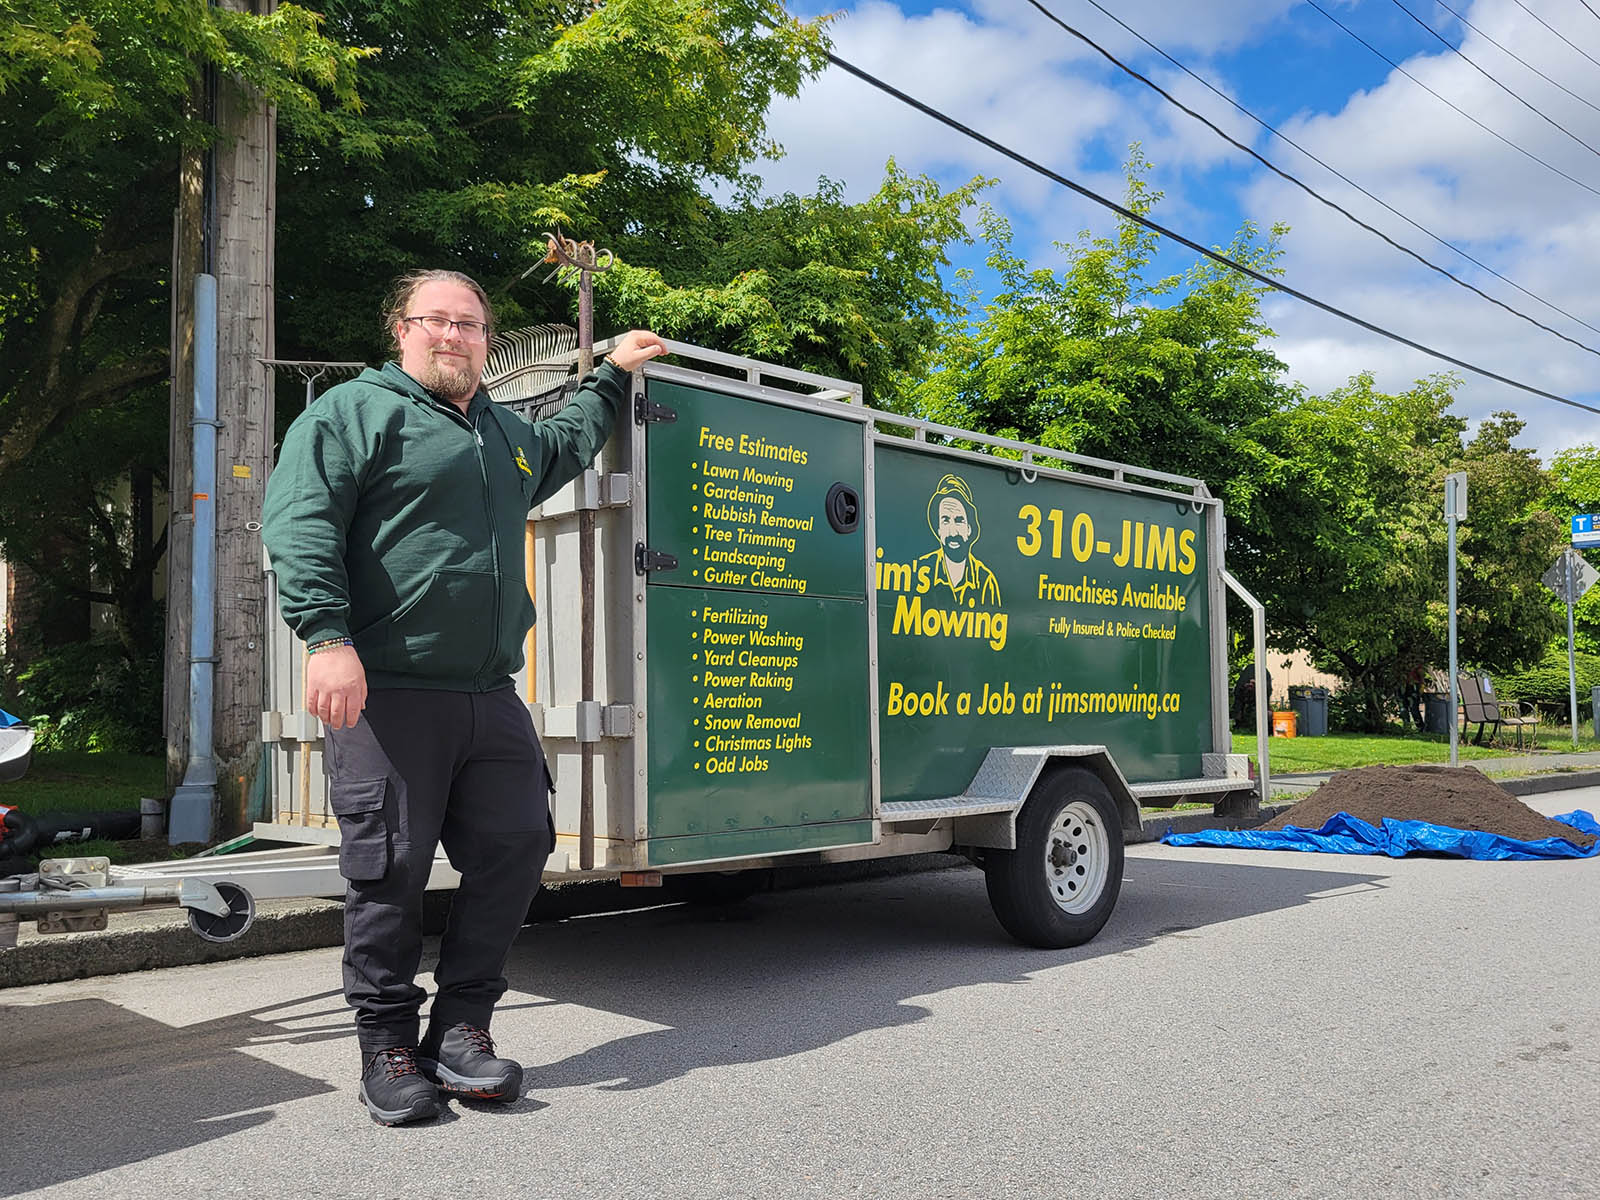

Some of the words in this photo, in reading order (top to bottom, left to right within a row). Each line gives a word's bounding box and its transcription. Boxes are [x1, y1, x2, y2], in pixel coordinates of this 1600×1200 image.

[698, 426, 735, 453] Free
[738, 433, 809, 465] Estimates
[703, 459, 740, 481] Lawn
[742, 466, 795, 493] Mowing
[703, 481, 775, 510] Gardening
[703, 502, 757, 524] Rubbish
[760, 509, 814, 532] Removal
[704, 523, 733, 543] Tree
[736, 527, 797, 553] Trimming
[1016, 503, 1197, 576] 310-JIMS
[703, 544, 786, 573] Landscaping
[875, 546, 931, 594] im's
[703, 566, 748, 587] Gutter
[750, 570, 808, 595] Cleaning
[1037, 573, 1119, 608] Franchises
[1120, 582, 1187, 612] Available
[702, 606, 769, 630] Fertilizing
[891, 595, 1009, 652] Mowing
[1048, 615, 1072, 639] Fully
[1072, 618, 1105, 637] Insured
[1105, 620, 1115, 637] &
[1115, 621, 1141, 639] Police
[1141, 623, 1177, 641] Checked
[703, 627, 746, 646] Power
[748, 629, 804, 652] Washing
[703, 649, 735, 667] Yard
[737, 650, 799, 672] Cleanups
[703, 670, 747, 688] Power
[749, 671, 794, 692] Raking
[703, 692, 763, 709] Aeration
[887, 682, 952, 717] Book
[956, 691, 972, 716] a
[976, 680, 1016, 716] Job
[1021, 686, 1044, 715] at
[1047, 681, 1181, 723] jimsmowing.ca
[703, 713, 743, 731] Snow
[745, 711, 801, 730] Removal
[705, 734, 772, 753] Christmas
[775, 732, 813, 753] Lights
[705, 755, 737, 774] Odd
[738, 754, 769, 773] Jobs
